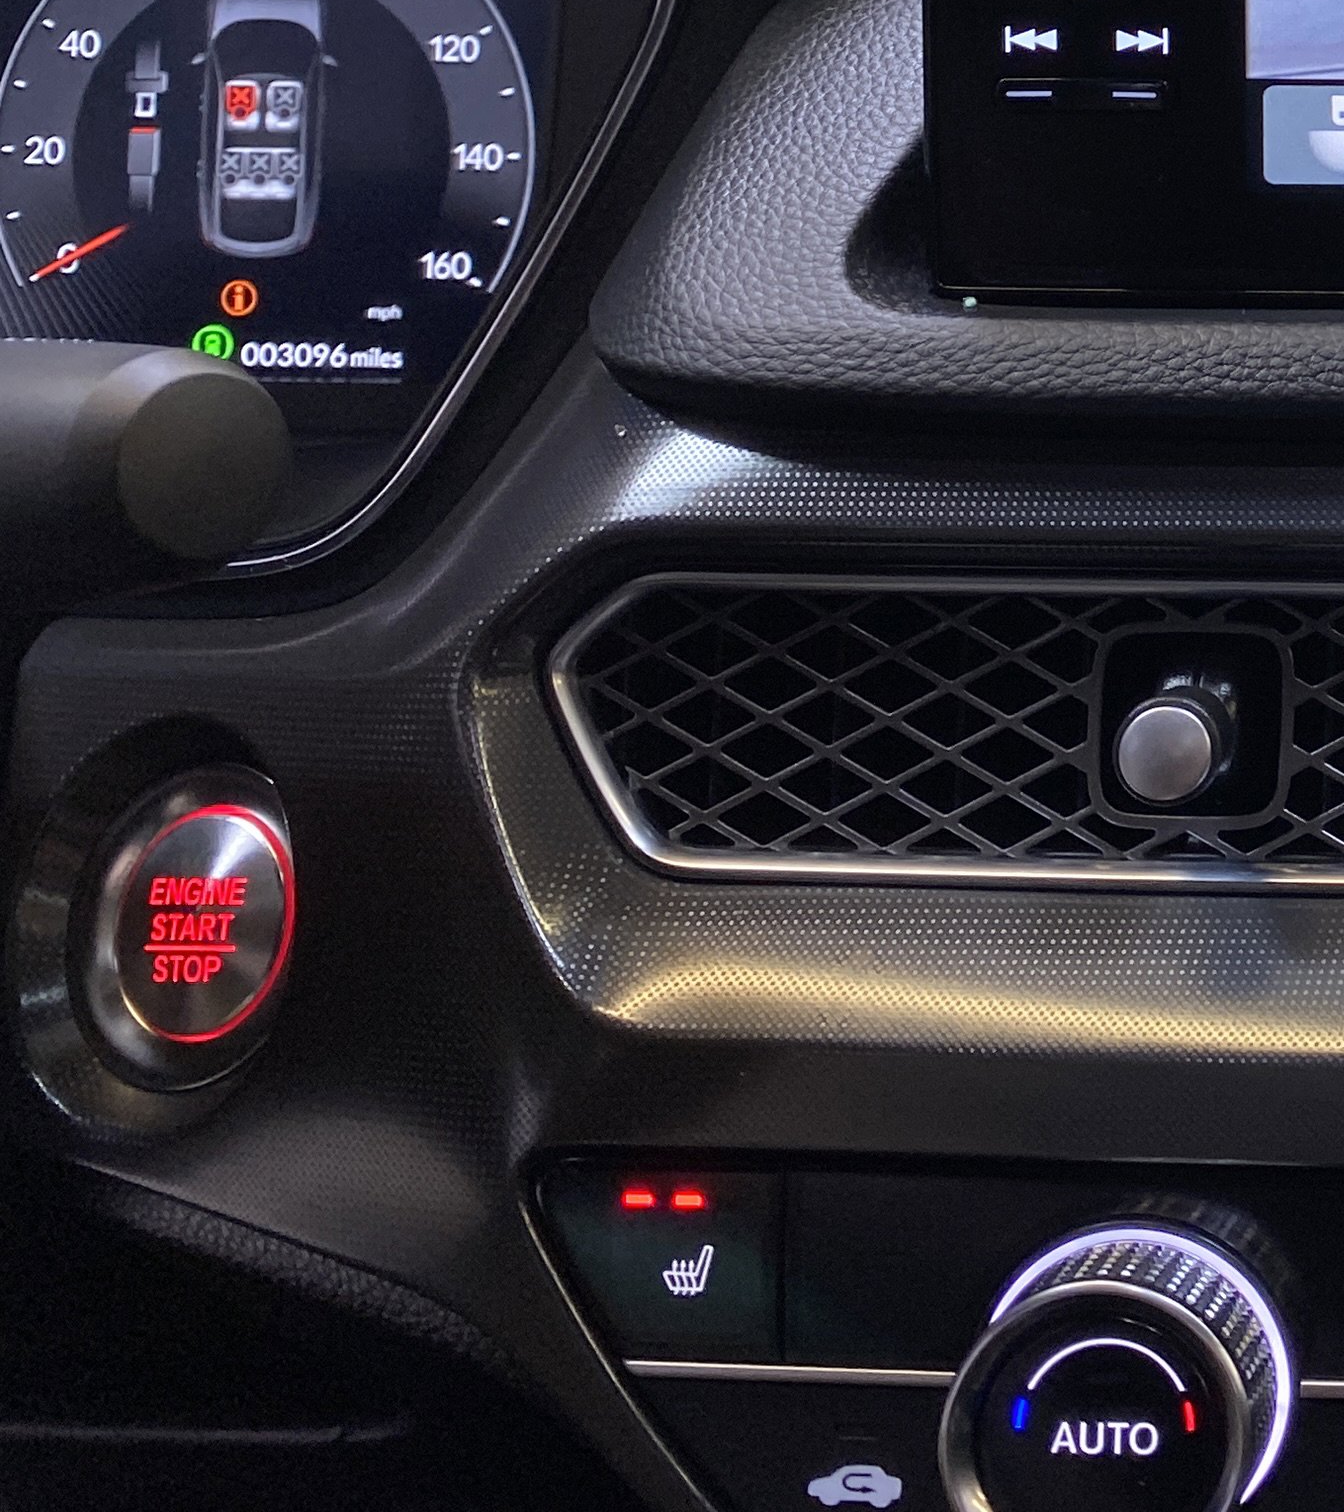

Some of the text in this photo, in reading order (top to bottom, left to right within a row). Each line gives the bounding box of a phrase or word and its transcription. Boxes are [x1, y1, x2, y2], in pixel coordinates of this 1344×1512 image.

[58, 29, 102, 59] 40
[429, 34, 481, 63] 120
[23, 135, 66, 165] 20
[452, 142, 504, 172] 140
[418, 251, 472, 280] 160
[366, 304, 403, 322] mph
[240, 341, 404, 369] 003096 miles
[148, 876, 248, 907] ENGINE
[150, 913, 235, 942] START
[152, 954, 223, 984] STOP
[1049, 1420, 1159, 1456] AUTO
